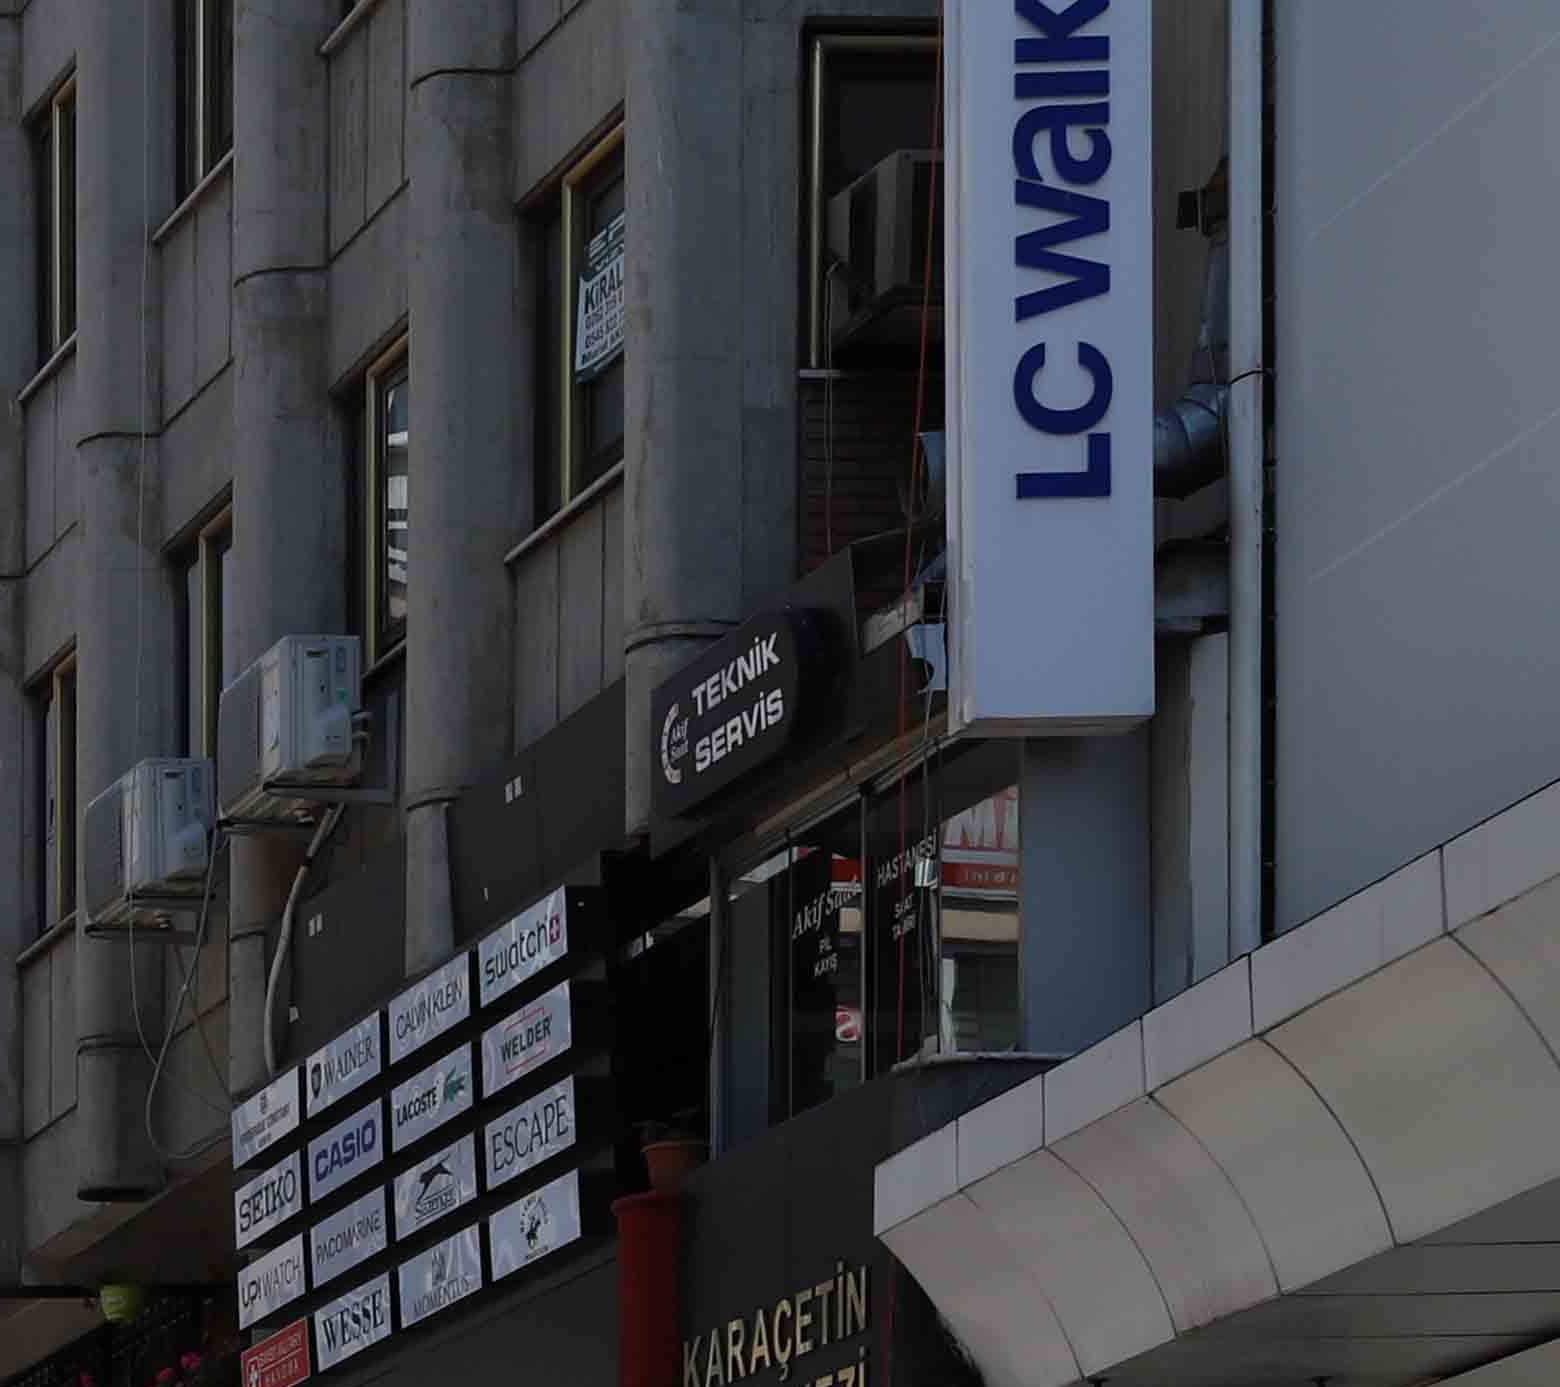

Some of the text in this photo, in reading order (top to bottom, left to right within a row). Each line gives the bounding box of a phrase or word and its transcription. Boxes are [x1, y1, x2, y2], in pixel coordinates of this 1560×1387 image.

[584, 262, 623, 315] KİRAL
[1012, 341, 1113, 498] LC
[691, 631, 781, 718] TEKNİK
[694, 688, 784, 774] SERVİS
[484, 916, 547, 987] swatch
[501, 1015, 553, 1063] WELDER
[396, 1087, 438, 1128] LACOSTE
[491, 1094, 567, 1175] ESCAPE
[314, 1117, 376, 1183] CASIO
[238, 1169, 298, 1233] SEIKO
[322, 1288, 386, 1354] WESSE
